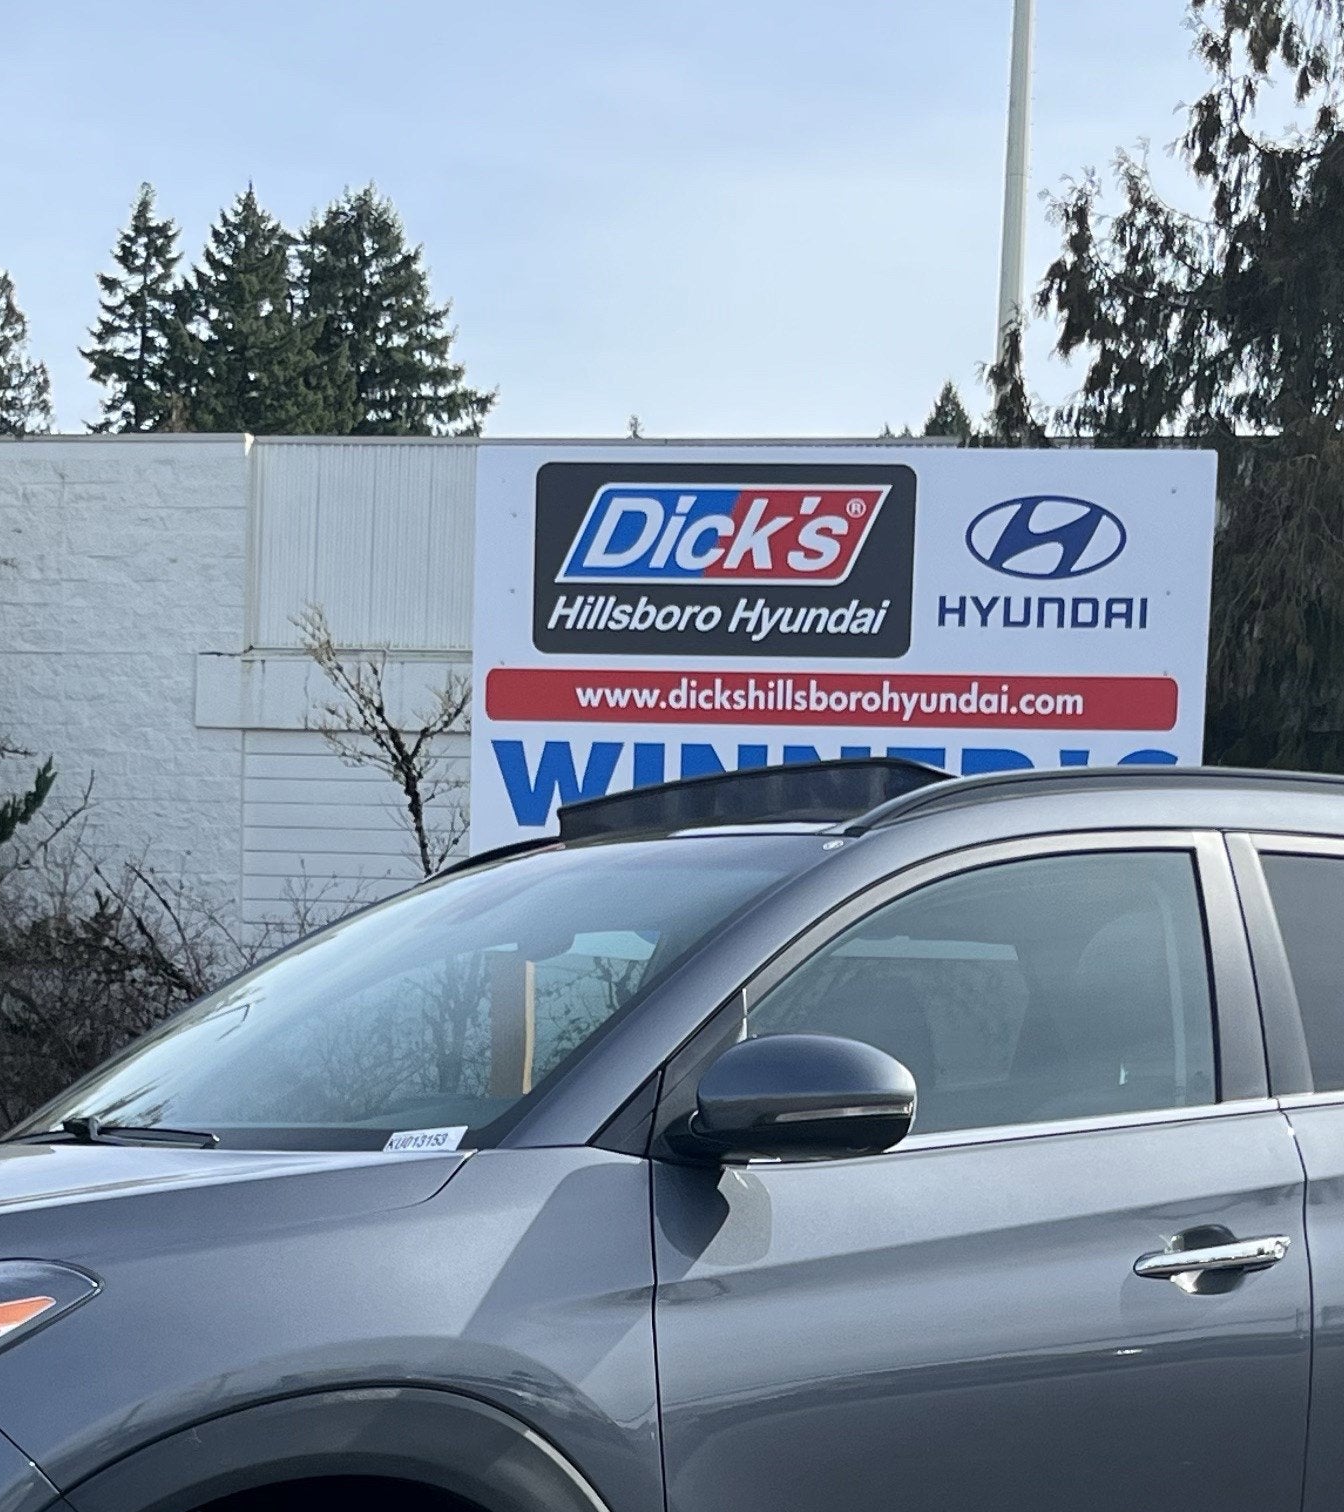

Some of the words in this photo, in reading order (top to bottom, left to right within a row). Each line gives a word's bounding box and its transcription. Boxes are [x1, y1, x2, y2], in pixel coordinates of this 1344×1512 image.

[581, 494, 854, 574] Dick's
[547, 595, 722, 635] Hillsboro
[727, 599, 890, 642] Hyundai
[938, 595, 1148, 630] HYUNDAI
[575, 677, 1084, 722] www.dickshillsborohyundai.com
